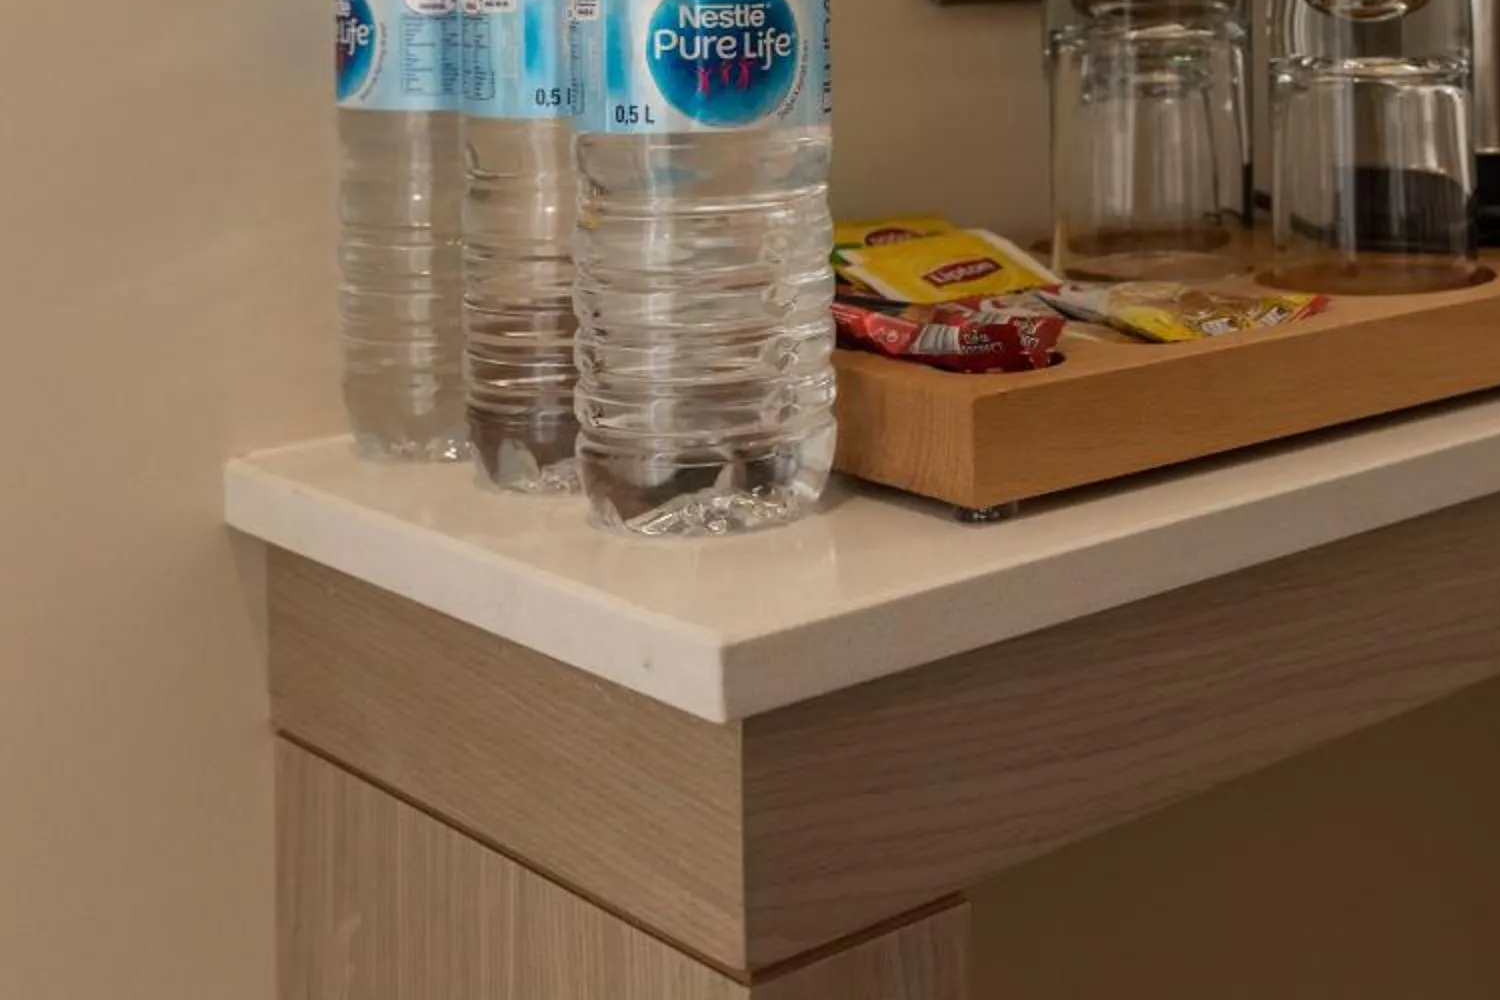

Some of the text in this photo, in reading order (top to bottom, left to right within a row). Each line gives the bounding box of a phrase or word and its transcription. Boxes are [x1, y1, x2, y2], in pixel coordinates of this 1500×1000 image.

[680, 3, 765, 29] Nestlé
[654, 27, 792, 70] Pure Life
[535, 87, 561, 108] 0,5
[615, 104, 655, 125] 0,5 L
[930, 260, 997, 284] Lipton
